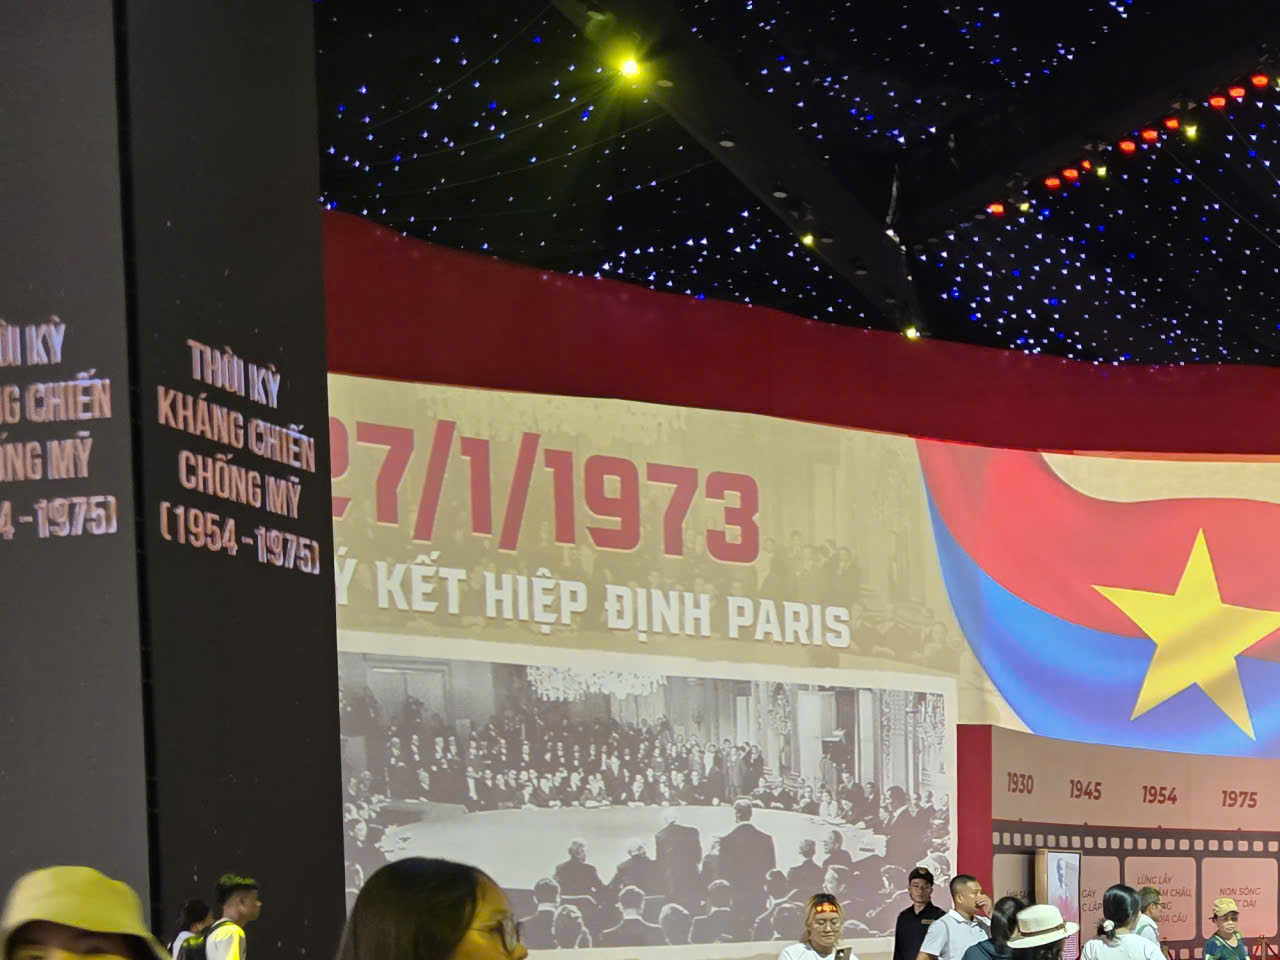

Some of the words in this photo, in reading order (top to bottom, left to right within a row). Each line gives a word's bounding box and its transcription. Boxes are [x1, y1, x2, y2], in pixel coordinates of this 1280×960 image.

[25, 314, 66, 366] KỲ
[25, 368, 112, 423] CHIẾN
[187, 338, 245, 397] THỜI
[248, 363, 281, 409] KỲ
[46, 430, 93, 480] MỸ
[157, 384, 244, 449] KHÁNG
[248, 418, 315, 473] CHIẾN
[178, 450, 262, 508] CHỐNG
[265, 475, 301, 519] MỸ
[375, 550, 467, 615] KẾT
[483, 567, 588, 635] HIỆP
[604, 582, 712, 643] ĐỊNH
[726, 594, 852, 649] PARIS
[1007, 771, 1035, 795] 1930
[1069, 779, 1103, 801] 1945
[1142, 785, 1178, 805] 1954
[1221, 789, 1258, 809] 1975
[1219, 887, 1238, 896] NON
